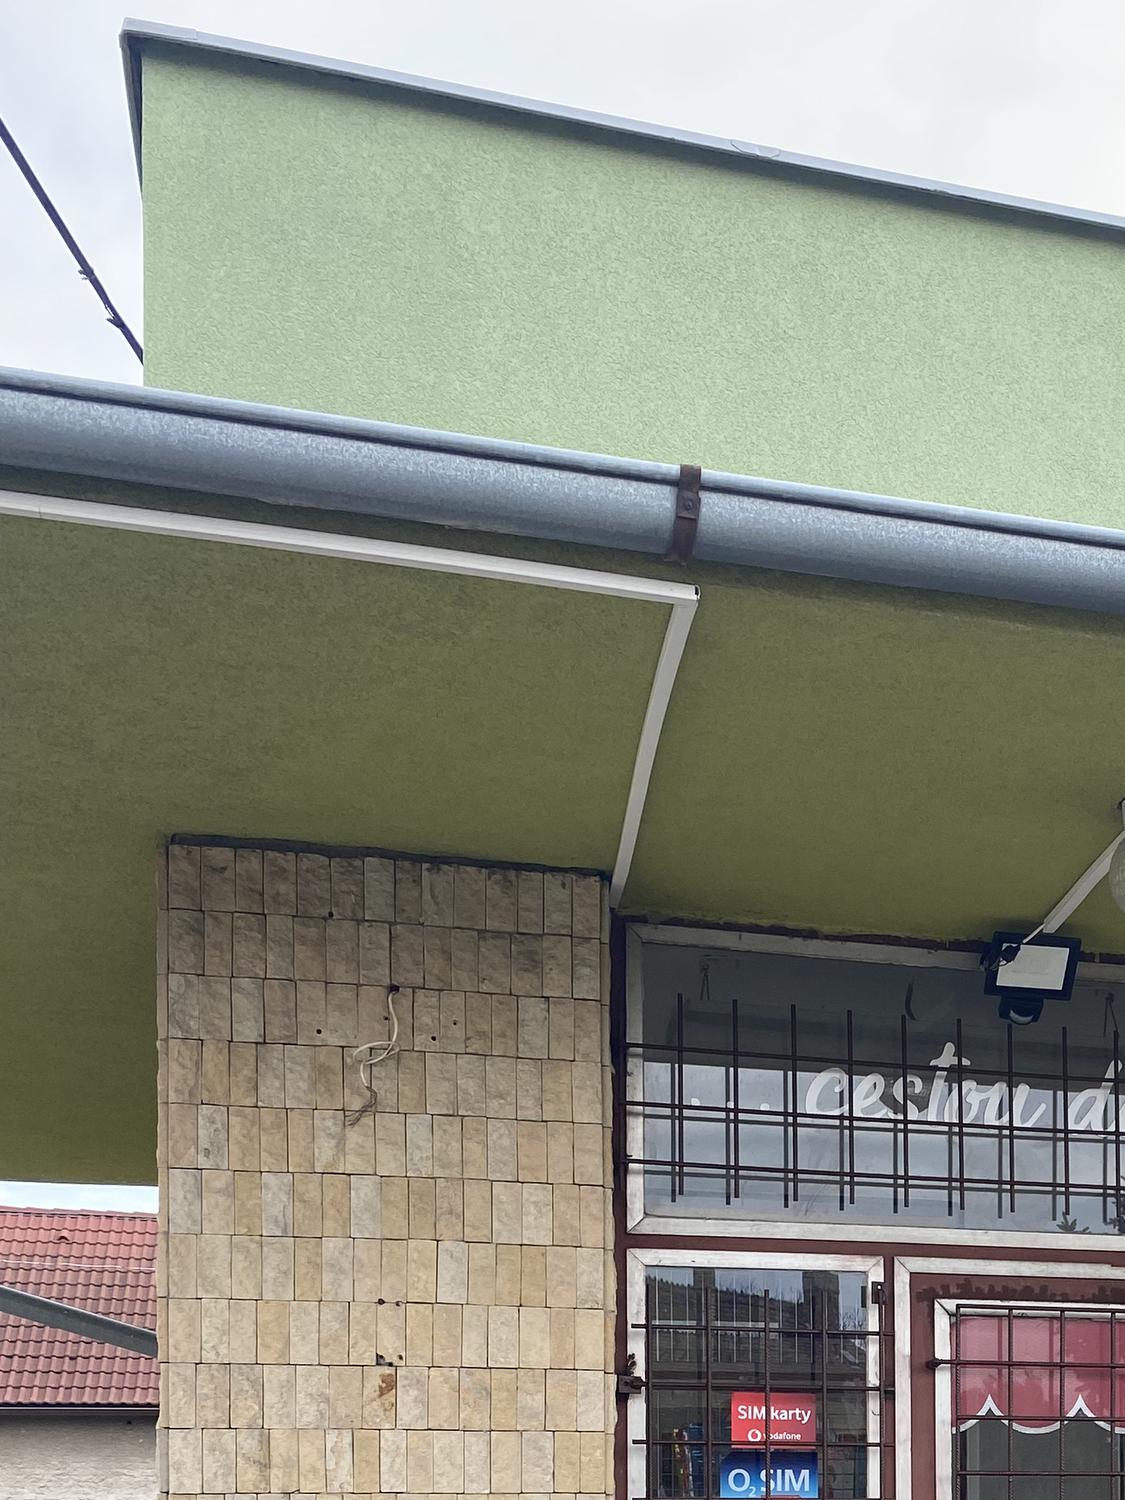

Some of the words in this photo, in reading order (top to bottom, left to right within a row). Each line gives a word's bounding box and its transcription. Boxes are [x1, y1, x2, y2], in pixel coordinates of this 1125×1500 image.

[805, 1042, 1046, 1128] cestou
[738, 1405, 766, 1420] SIM
[770, 1406, 811, 1424] karty
[763, 1431, 802, 1441] vodafone
[760, 1469, 810, 1492] SIM
